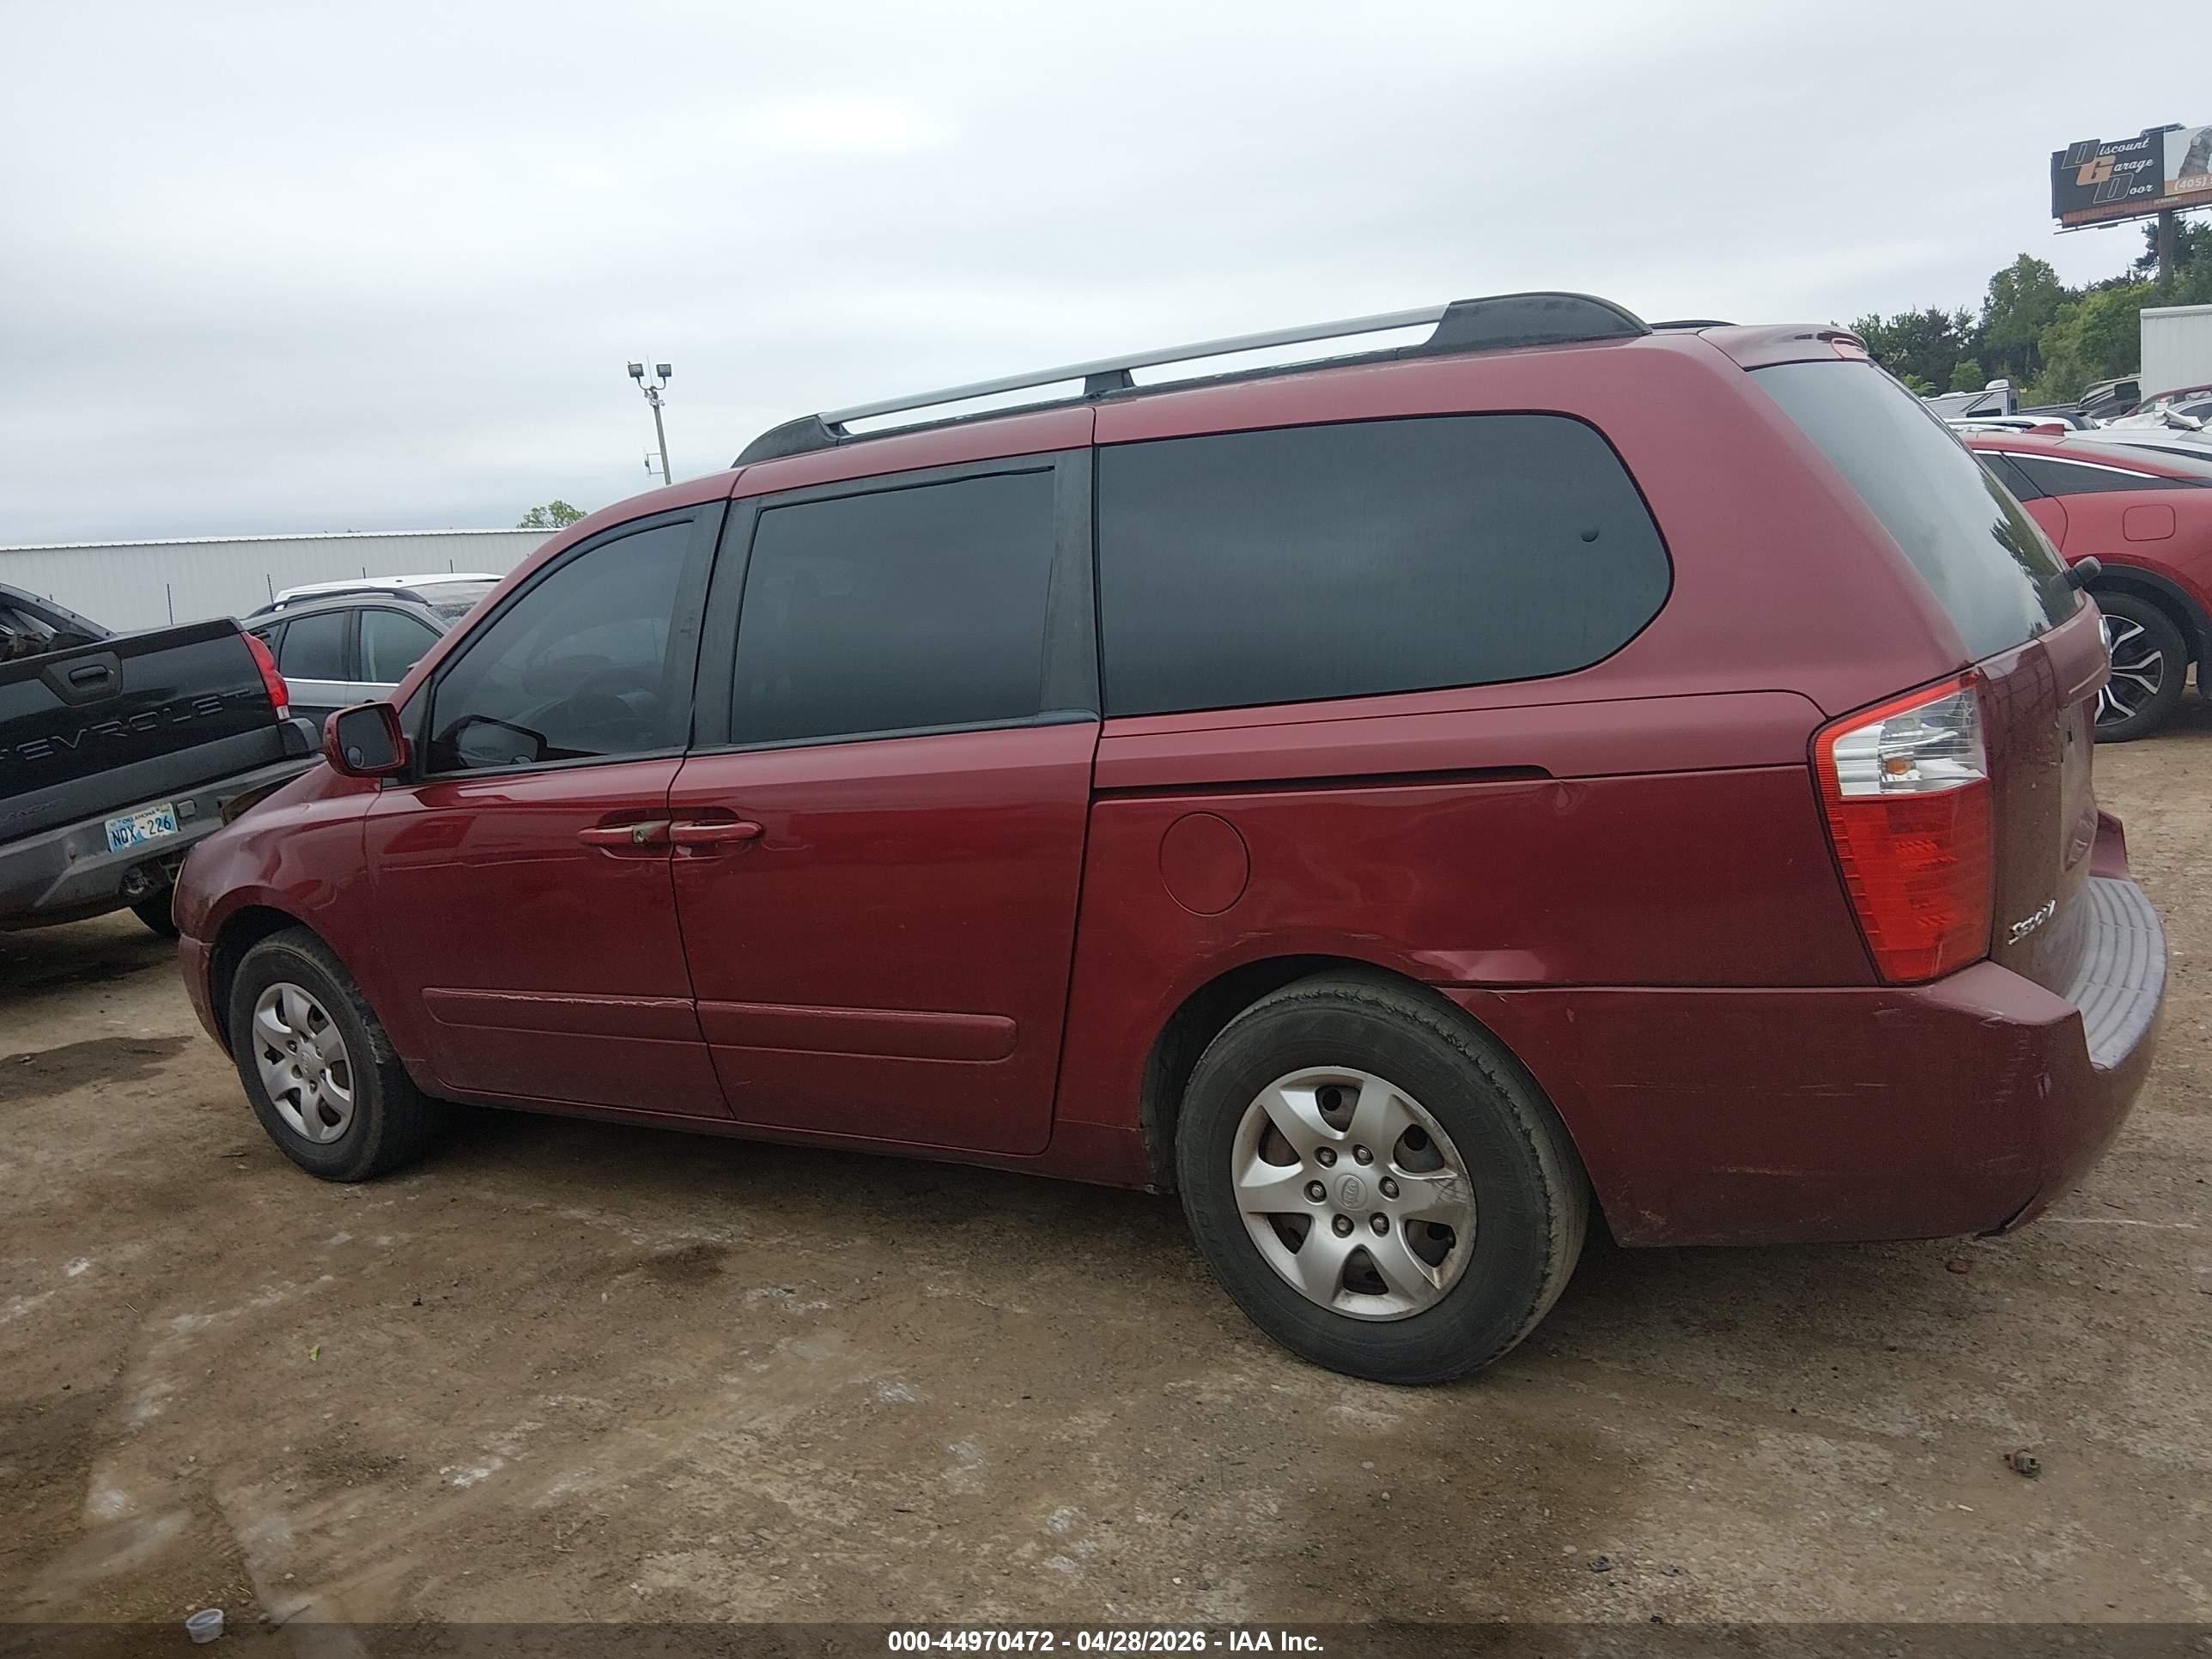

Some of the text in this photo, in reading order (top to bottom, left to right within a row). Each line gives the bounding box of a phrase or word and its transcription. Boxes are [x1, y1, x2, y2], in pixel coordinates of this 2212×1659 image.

[2061, 138, 2150, 169] Discount
[2076, 155, 2154, 185] Garage
[2174, 176, 2207, 191] (405)
[2093, 173, 2154, 204] Door
[0, 688, 250, 761] EVROLET
